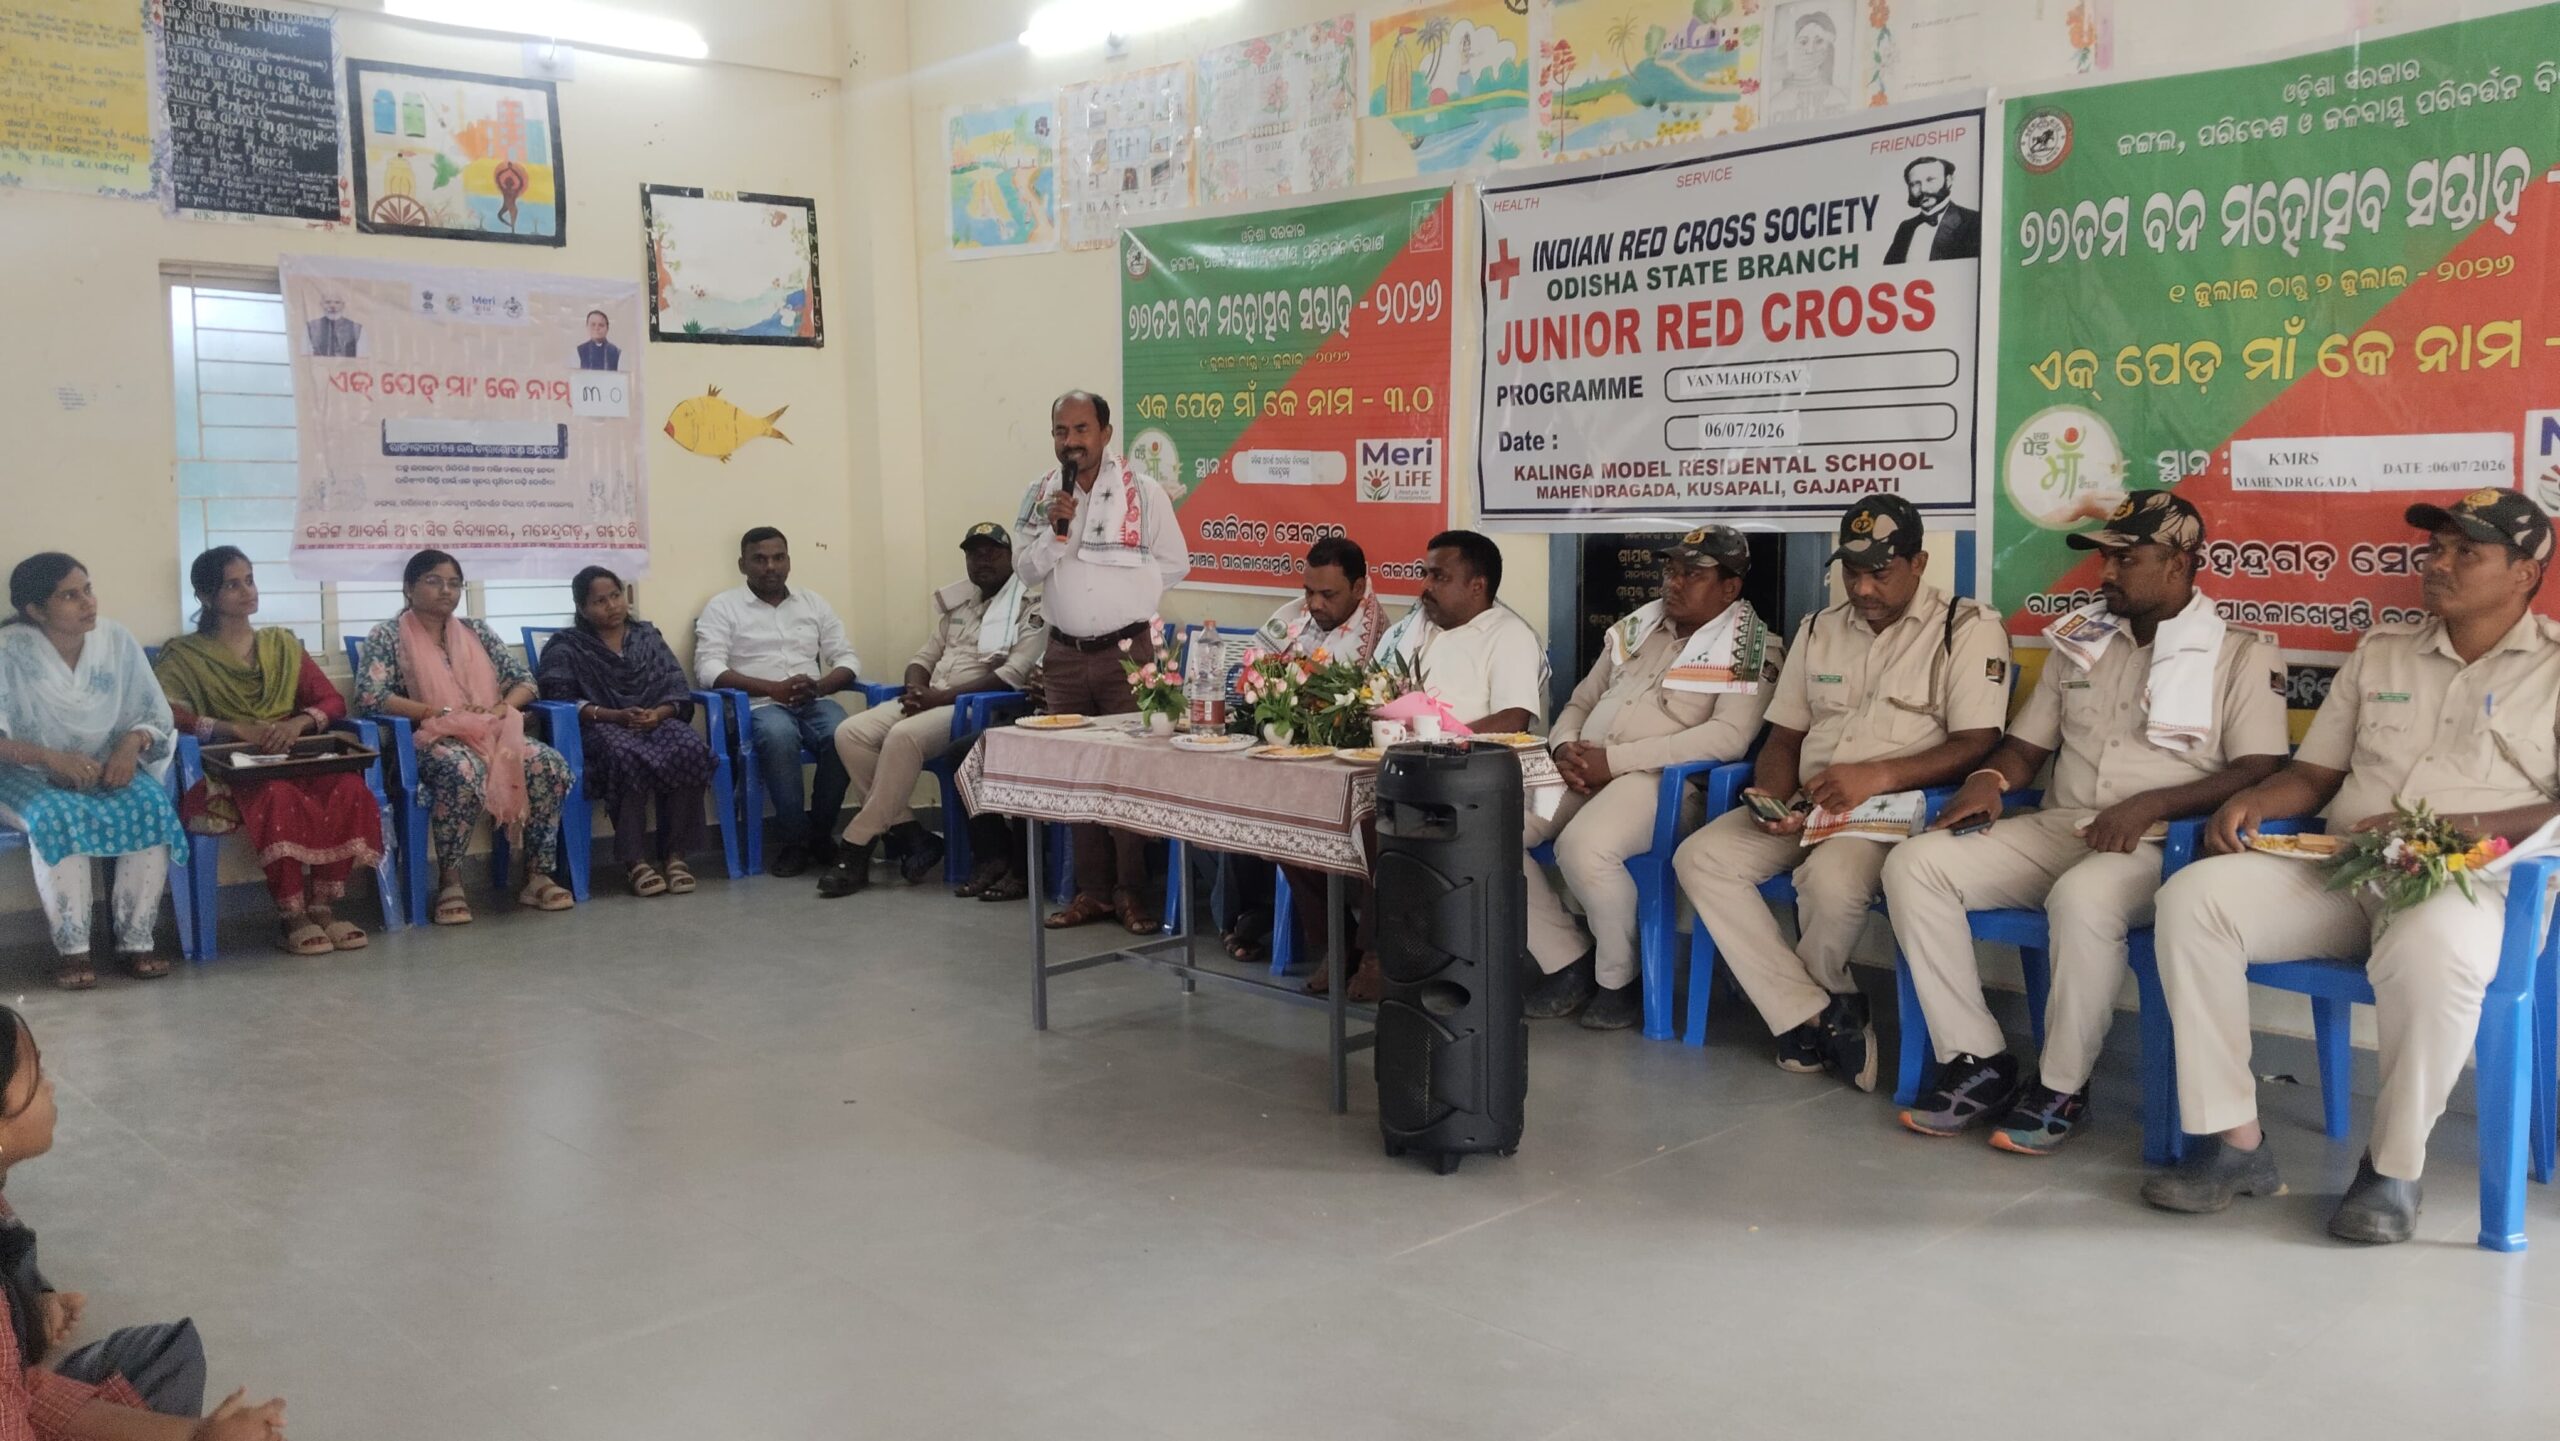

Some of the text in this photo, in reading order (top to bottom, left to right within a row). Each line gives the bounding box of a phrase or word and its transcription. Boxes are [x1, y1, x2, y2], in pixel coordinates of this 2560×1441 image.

[2283, 58, 2421, 107] ଓଡ଼ିଶା ସରକାର
[2198, 116, 2290, 148] ପରିବେଶ
[2299, 109, 2313, 135] ଓ
[2322, 96, 2409, 129] ଜଳବାୟୁ
[1869, 127, 1967, 156] FRIENDSHIP
[1676, 166, 1733, 189] SERVICE
[1493, 197, 1540, 213] HEALTH
[2142, 189, 2207, 254] ବନ
[2220, 165, 2392, 259] ମହୋତ୍ସବ
[2405, 145, 2532, 236] ସପ୍ତାହ
[1532, 195, 1880, 273] INDIAN RED CROSS SOCIETY
[1546, 244, 1860, 303] ODISHA STATE BRANCH
[2193, 276, 2259, 309] ଜୁଲାଇ
[2340, 264, 2409, 298] ଜୁଲାଇ
[2436, 253, 2516, 284] ୨୦୨୬
[1183, 296, 1212, 339] ବନ
[1497, 279, 1937, 366] JUNIOR RED CROSS
[2115, 340, 2223, 394] ପେଡ଼
[2242, 316, 2307, 382] ମାଁ
[2317, 329, 2396, 380] କେ
[2415, 318, 2523, 373] ନାମ
[485, 377, 520, 399] କେ
[1263, 390, 1299, 417] କେ
[1306, 386, 1354, 416] ନାମ
[1497, 375, 1643, 407] PROGRAMME
[1499, 430, 1545, 454] Date
[1704, 422, 1785, 440] 06/07/2026
[1362, 438, 1433, 467] Meri
[1513, 451, 1934, 482] KALINGA MODEL RESIDENTAL SCHOOL
[2157, 448, 2211, 484] ସ୍ଥାନ
[2268, 451, 2320, 467] KMRS
[1395, 470, 1432, 488] LiFE
[2236, 474, 2358, 489] MAHENDRAGADA
[2383, 462, 2426, 476] DATE
[1536, 476, 1900, 501] MAHENDRAGADA, KUSAPALI, GAJAPATI
